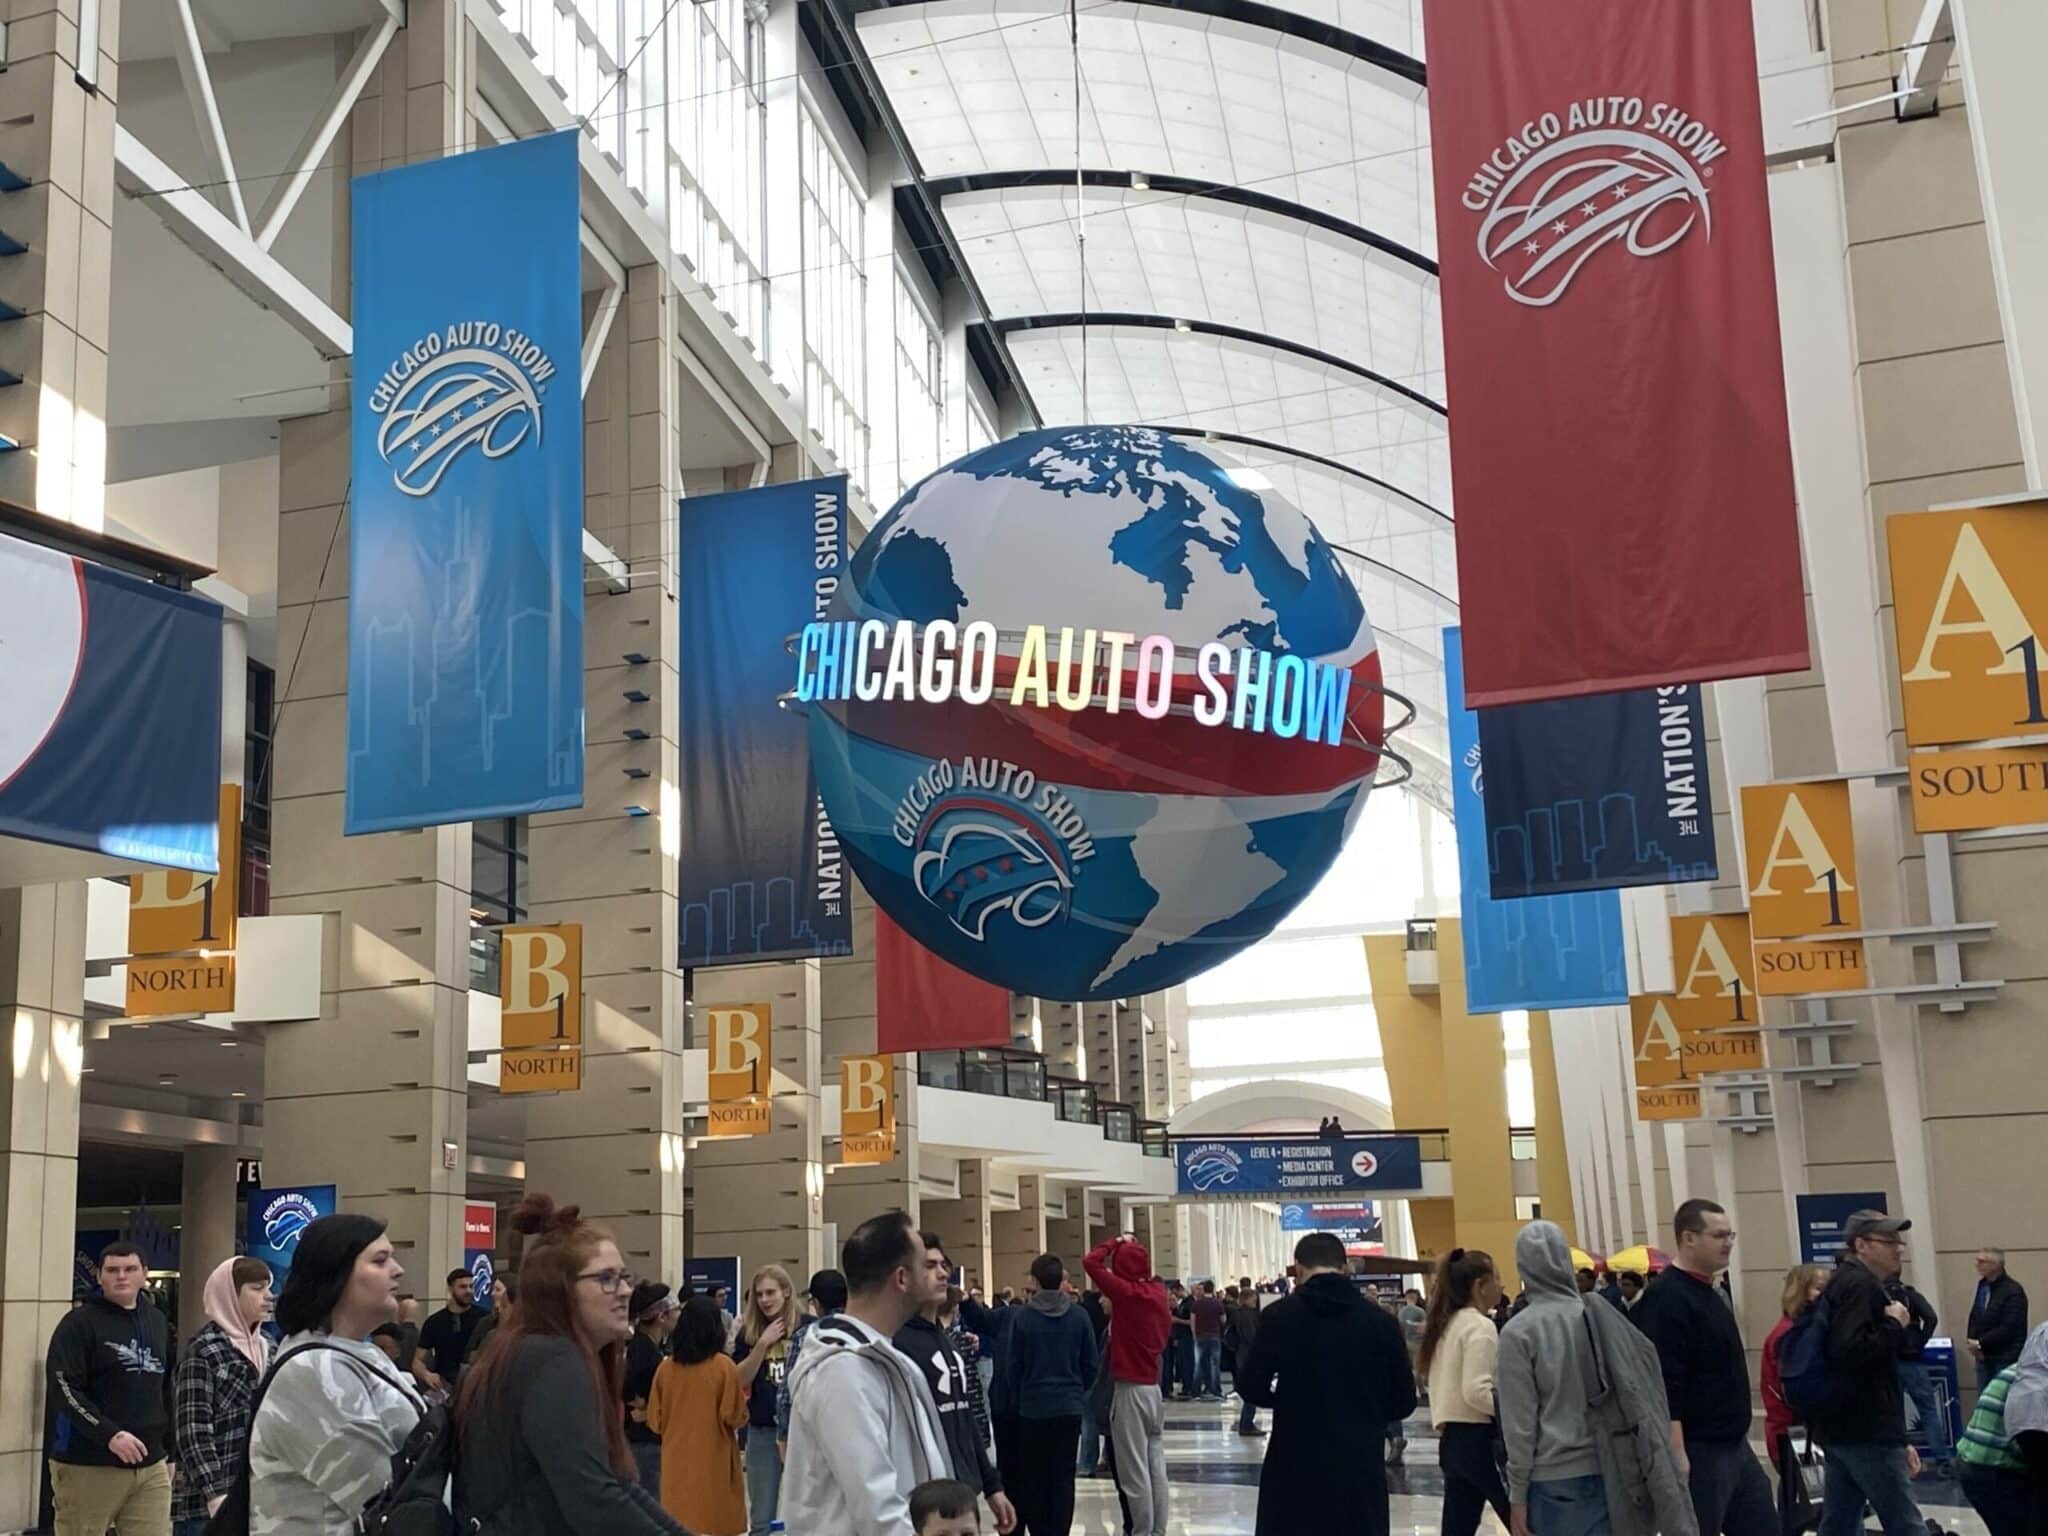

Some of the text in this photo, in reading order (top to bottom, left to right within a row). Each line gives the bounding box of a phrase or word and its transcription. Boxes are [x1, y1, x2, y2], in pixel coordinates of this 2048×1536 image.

[1462, 96, 1727, 211] CHICAGO AUTO SHOW
[369, 321, 555, 413] CHICAGO AUTO SHOW
[815, 493, 838, 570] SHOW
[797, 619, 1352, 747] CHICAGO AUTO SHOW
[893, 756, 1096, 861] CHICAGO AUTO SHOW
[1679, 819, 1699, 836] THE
[825, 902, 841, 916] THE
[1761, 950, 1859, 973] SOUTH
[130, 967, 224, 993] NORTH
[1684, 1039, 1756, 1056] SOUTH
[504, 1057, 574, 1076] NORTH
[1638, 1093, 1697, 1107] SOUTH
[711, 1107, 767, 1123] NORTH
[844, 1139, 892, 1153] NORTH
[1250, 1146, 1270, 1159] LEVEL
[1282, 1146, 1331, 1158] REGISTRATION
[1282, 1160, 1334, 1172] MEDIA CENTER
[1282, 1174, 1344, 1187] EXHIBITOR OFFICE
[262, 1194, 286, 1221] CHICAGO
